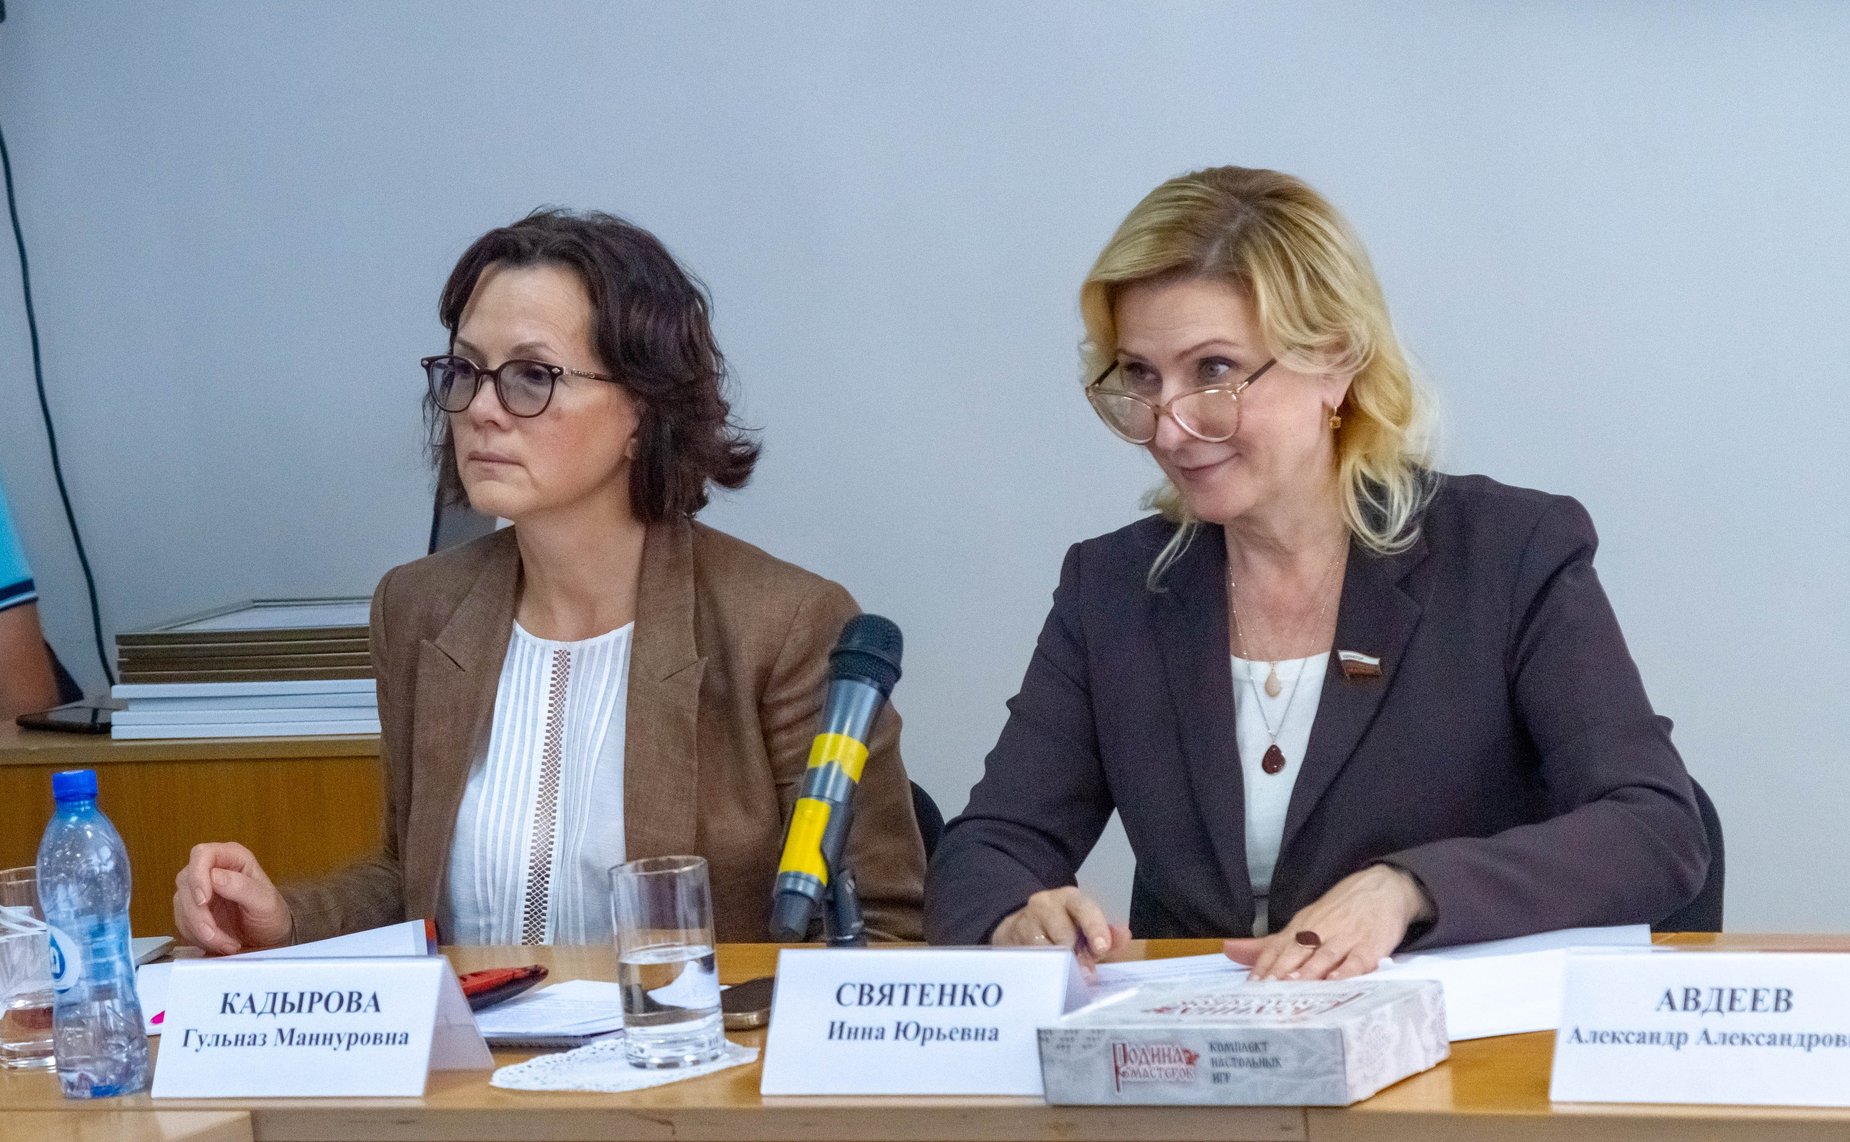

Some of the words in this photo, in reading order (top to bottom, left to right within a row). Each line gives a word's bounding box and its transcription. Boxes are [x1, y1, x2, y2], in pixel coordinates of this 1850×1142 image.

[219, 990, 382, 1019] КАДЫРОВА
[835, 982, 1004, 1008] СВЯТЕНКО
[1656, 986, 1795, 1017] АВДЕЕВ
[182, 1027, 268, 1053] Гульназ
[273, 1027, 410, 1052] Маннуровна
[827, 1020, 886, 1041] Инна
[893, 1020, 1000, 1047] Юрьевна
[1568, 1026, 1689, 1051] Александр
[1697, 1027, 1850, 1053] Александров
[1209, 1041, 1269, 1053] КОМПЛЕКТ
[1211, 1056, 1282, 1069] НАСТОЛЬНЫХ
[1212, 1072, 1231, 1084] ИГР
